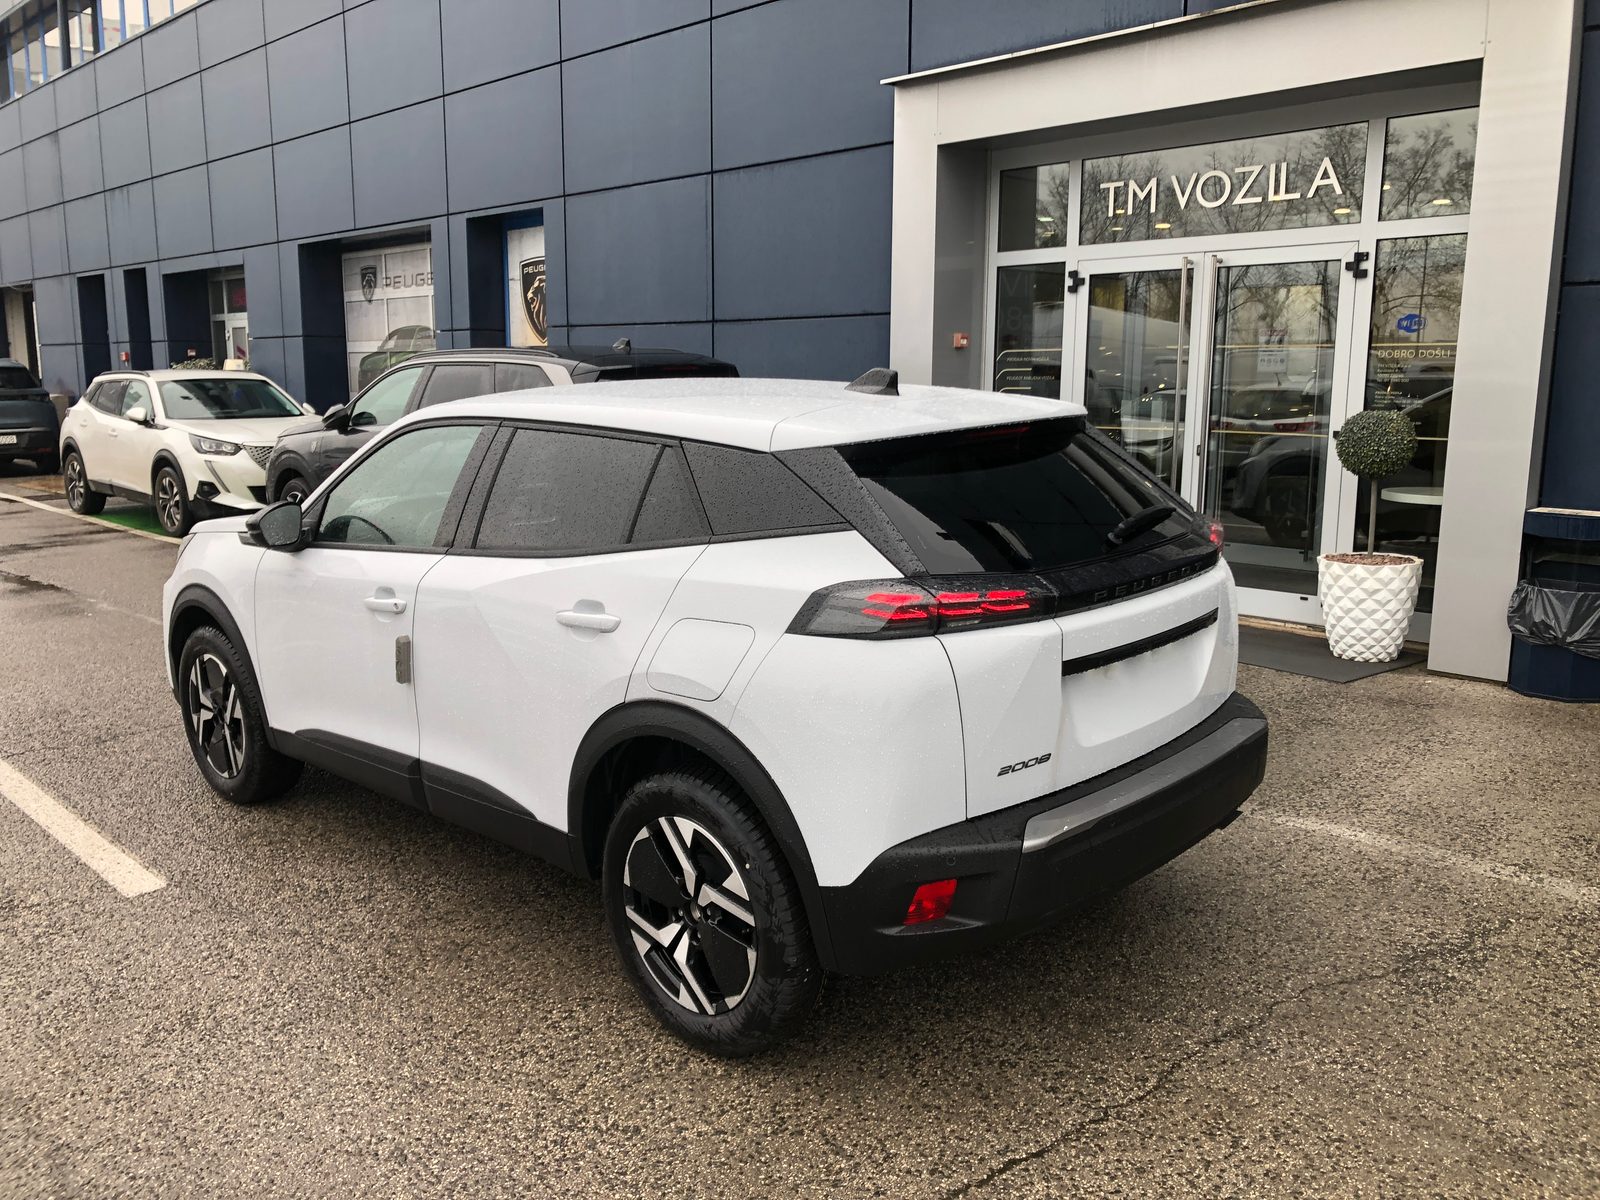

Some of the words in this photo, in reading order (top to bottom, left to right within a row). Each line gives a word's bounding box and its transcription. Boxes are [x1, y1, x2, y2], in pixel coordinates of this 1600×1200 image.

[1100, 177, 1158, 217] TM
[1171, 156, 1343, 210] VOZILA
[1378, 349, 1416, 359] DOBRO
[1418, 347, 1450, 358] DOŠLI
[1094, 561, 1202, 602] PEUGEOT
[997, 753, 1052, 777] 2008
